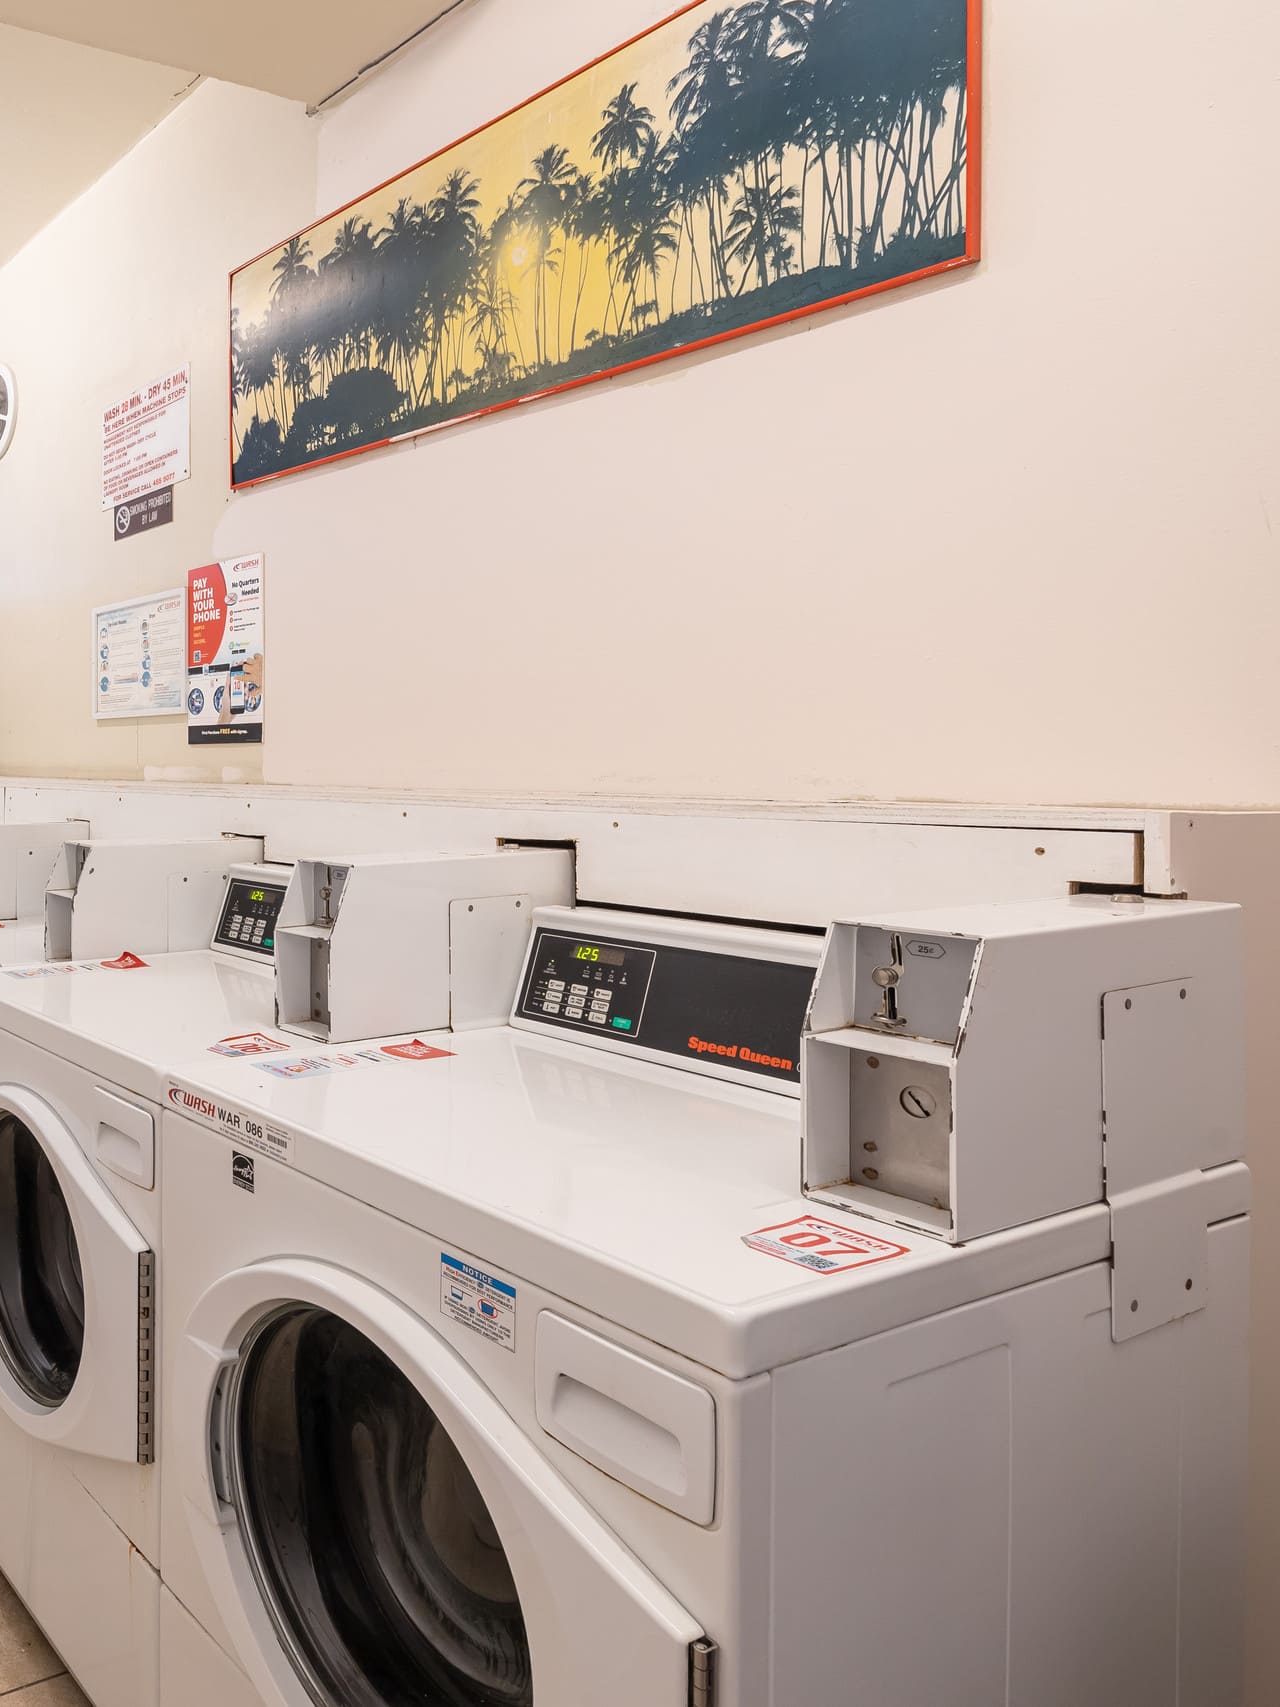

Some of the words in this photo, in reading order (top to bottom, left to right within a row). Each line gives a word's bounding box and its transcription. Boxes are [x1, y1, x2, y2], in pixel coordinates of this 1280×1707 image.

[105, 405, 120, 422] WASH
[130, 393, 142, 409] MIN.
[149, 384, 161, 399] DRY
[163, 378, 171, 392] 45
[173, 370, 187, 387] MIN.
[105, 424, 111, 433] BE
[112, 418, 125, 430] HERE
[127, 409, 141, 423] WHEN
[143, 397, 166, 415] MACHINE
[168, 386, 186, 402] STOPS
[141, 482, 151, 491] CALL
[129, 501, 147, 517] SMOKING
[148, 510, 158, 523] LAW
[193, 577, 208, 590] PAY
[239, 578, 259, 588] Quarters
[192, 587, 214, 601] WITH
[242, 587, 259, 596] Needed
[192, 599, 215, 612] YOUR
[193, 609, 221, 624] PHONE
[688, 1036, 738, 1058] Speed
[739, 1047, 793, 1071] Queen
[183, 1091, 216, 1117] WASH
[218, 1107, 240, 1129] WAR
[245, 1120, 263, 1138] 086
[779, 1232, 871, 1256] 07
[462, 1264, 493, 1284] NOTICE
